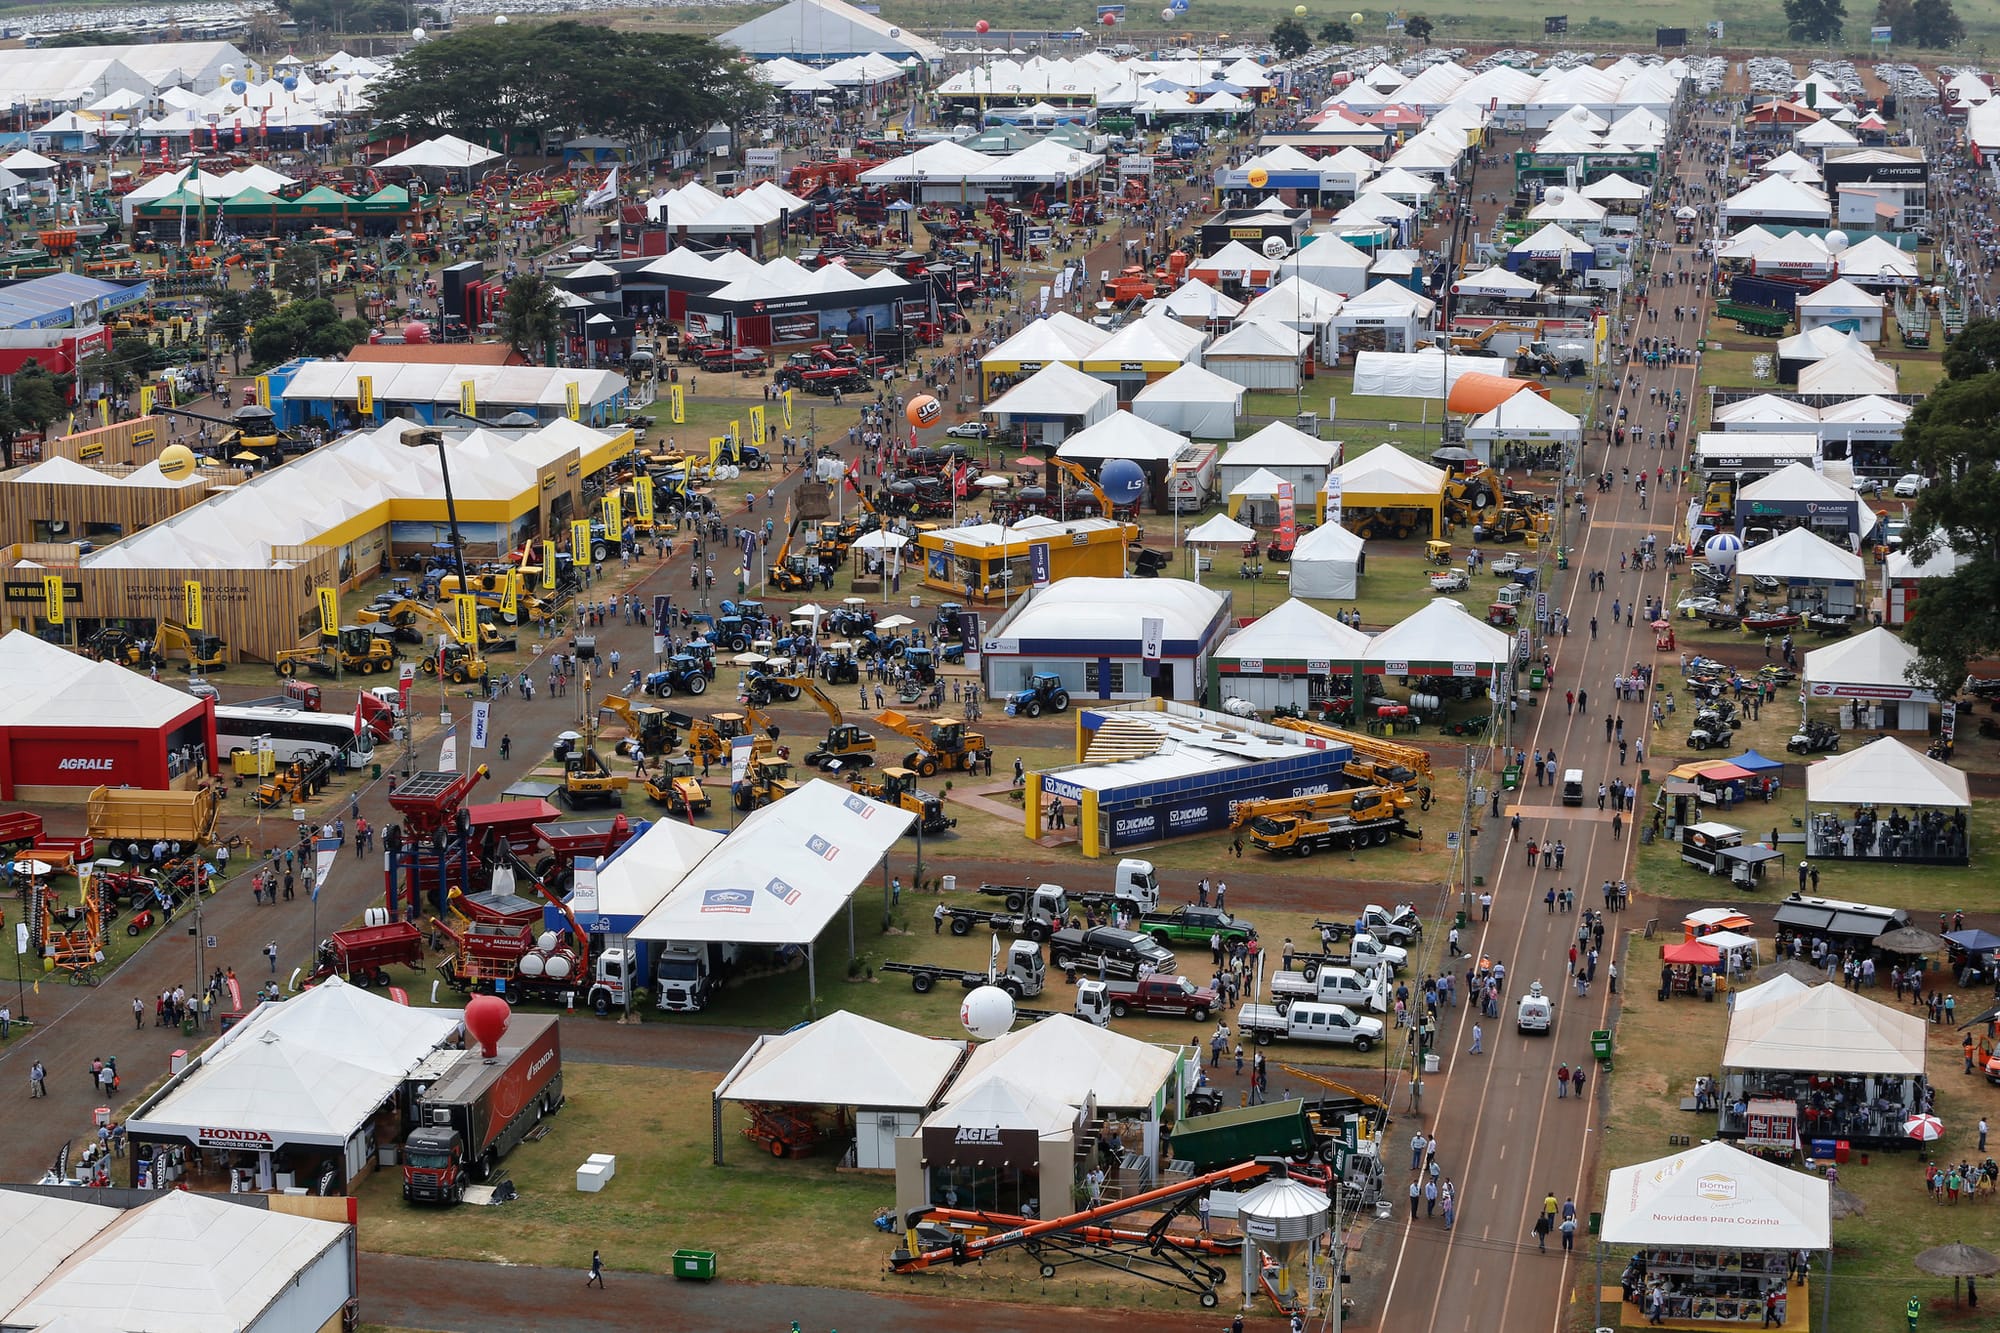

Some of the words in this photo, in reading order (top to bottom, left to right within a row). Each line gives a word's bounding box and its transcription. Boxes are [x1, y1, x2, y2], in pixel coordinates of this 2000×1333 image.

[1127, 481, 1141, 489] LS
[9, 587, 26, 597] NEW
[1537, 594, 1545, 620] KBM
[967, 636, 976, 650] LS
[985, 642, 998, 650] LS
[1148, 642, 1156, 657] LS
[1241, 660, 1262, 668] KBM
[1308, 661, 1330, 669] KBM
[1386, 662, 1407, 670] KBM
[475, 718, 484, 740] XCMG
[58, 758, 114, 770] AGRALE
[1054, 781, 1082, 800] XCMG
[1179, 807, 1208, 821] XCMG
[1126, 816, 1155, 830] XCMG
[532, 1048, 554, 1076] HONDA
[198, 1128, 273, 1142] HONDA
[955, 1128, 986, 1141] AGI
[1653, 1214, 1708, 1222] Novidades
[1737, 1217, 1780, 1225] Cozinha
